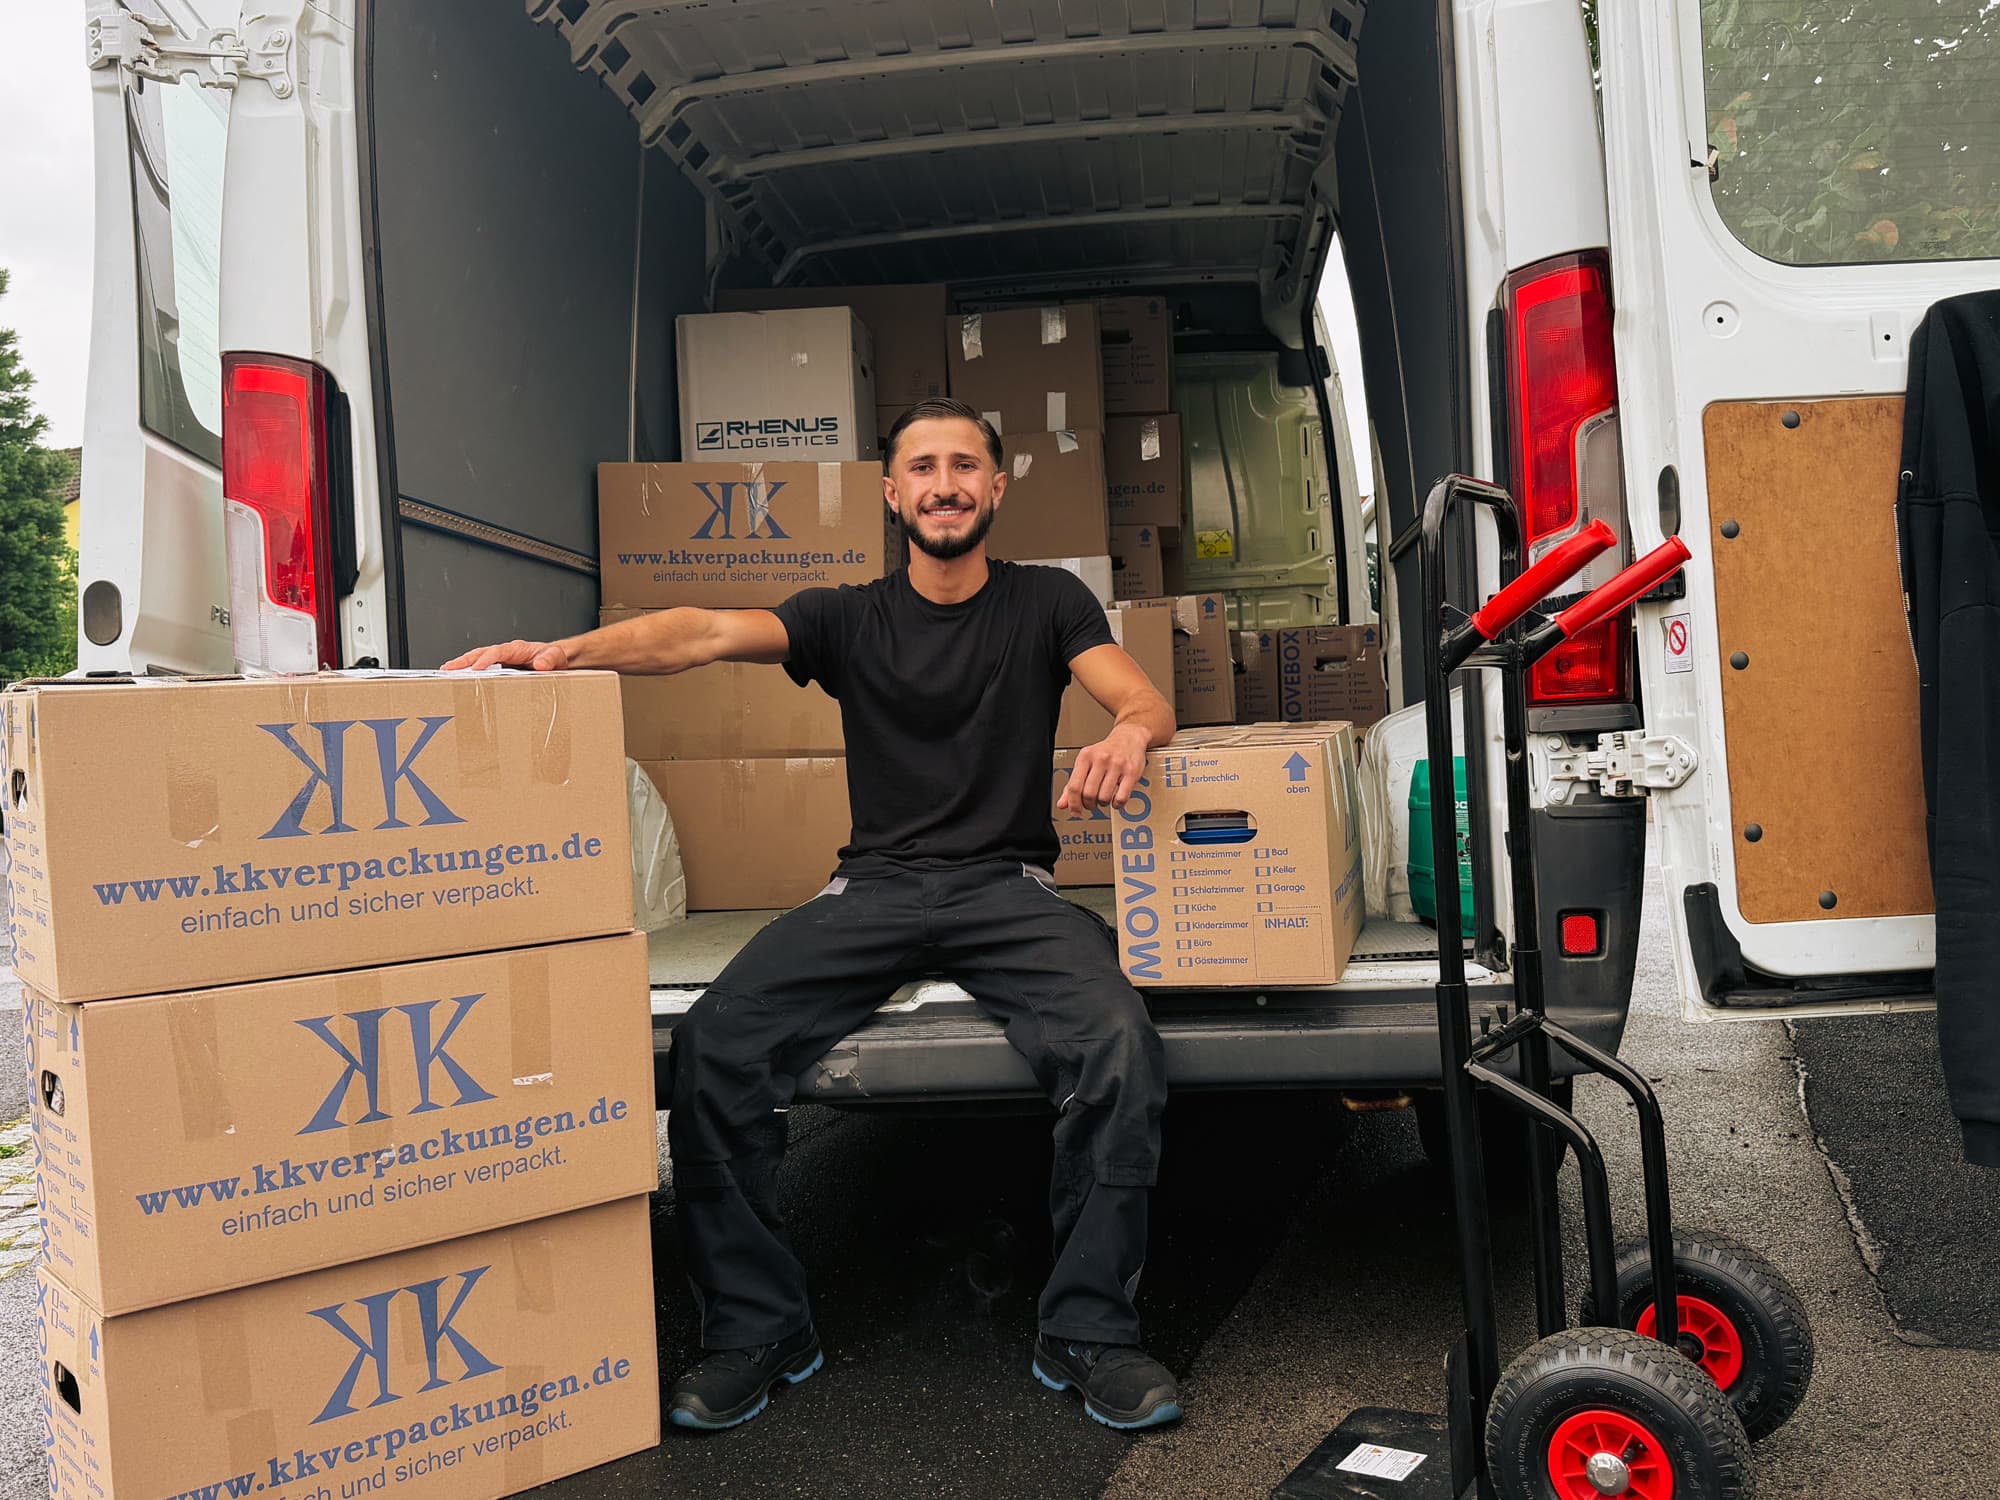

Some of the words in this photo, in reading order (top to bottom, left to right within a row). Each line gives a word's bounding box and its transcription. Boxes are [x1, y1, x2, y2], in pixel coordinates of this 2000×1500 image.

[726, 417, 838, 436] RHENUS
[726, 434, 839, 450] LOGISTICS
[617, 549, 866, 569] www.kkverpackungen.de
[653, 569, 698, 582] einfach
[702, 569, 726, 582] und
[730, 569, 768, 582] sicher
[773, 569, 829, 584] verpackt.
[1283, 630, 1301, 721] OVEBOX
[1190, 758, 1218, 768] schwer
[1190, 773, 1240, 783] zerbrechlich
[1286, 784, 1310, 794] oben
[1187, 850, 1241, 859] Wohnzimmer
[1271, 848, 1288, 857] Bad
[94, 832, 603, 905] www.kkverpackungen.de
[1119, 759, 1163, 980] MOVEBO
[1272, 865, 1297, 875] Keller
[1190, 886, 1245, 895] Schlafzimmer
[1273, 884, 1306, 893] Garage
[180, 900, 281, 935] einfach
[290, 895, 339, 923] und
[348, 889, 425, 916] sicher
[432, 876, 540, 911] verpackt.
[1191, 903, 1217, 912] Küche
[1192, 921, 1249, 930] Kinderzimmer
[1264, 917, 1309, 929] INHALT:
[1193, 939, 1213, 947] Büro
[135, 1097, 628, 1218] www.kkverpackungen.de
[221, 1197, 318, 1237] einfach
[327, 1184, 375, 1214] und
[382, 1172, 457, 1202] sicher
[463, 1146, 567, 1189] verpackt.
[341, 1466, 387, 1499] und
[394, 1455, 467, 1488] sicher
[472, 1410, 572, 1458] verpackt.
